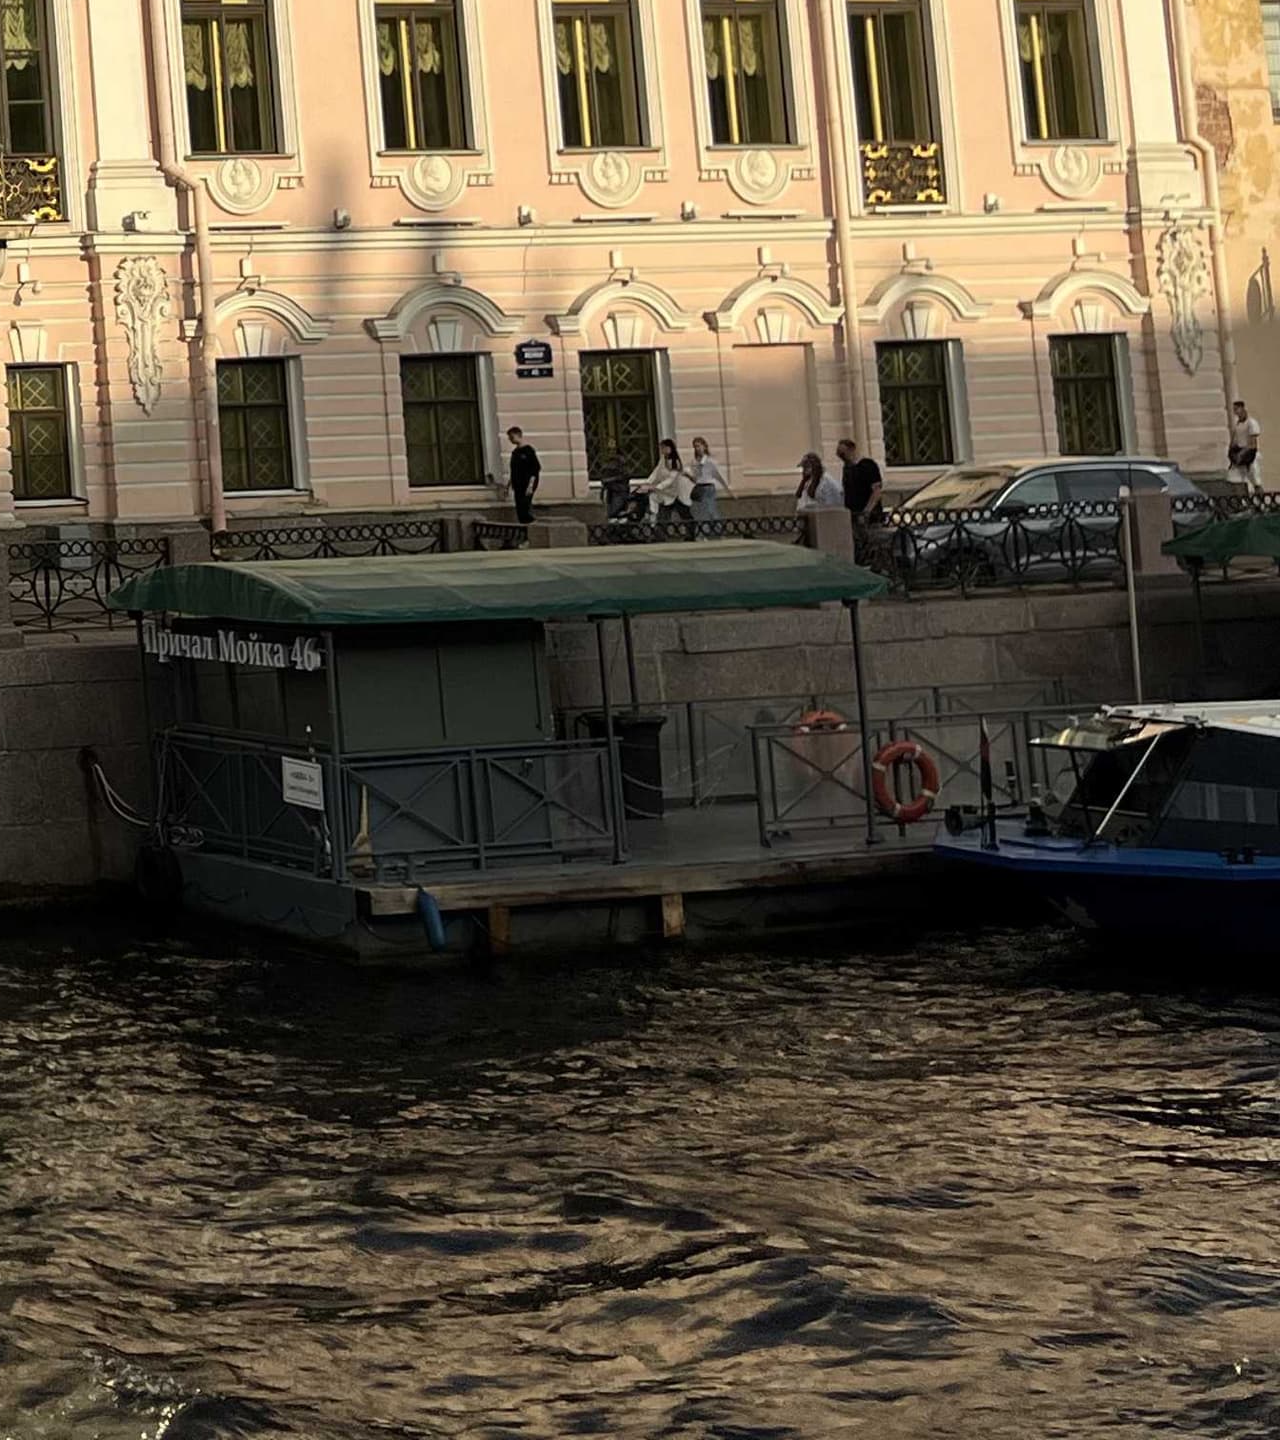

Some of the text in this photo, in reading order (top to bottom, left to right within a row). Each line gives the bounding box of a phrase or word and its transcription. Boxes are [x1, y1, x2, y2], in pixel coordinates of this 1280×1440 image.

[142, 618, 321, 672] Причал Мойка 46
